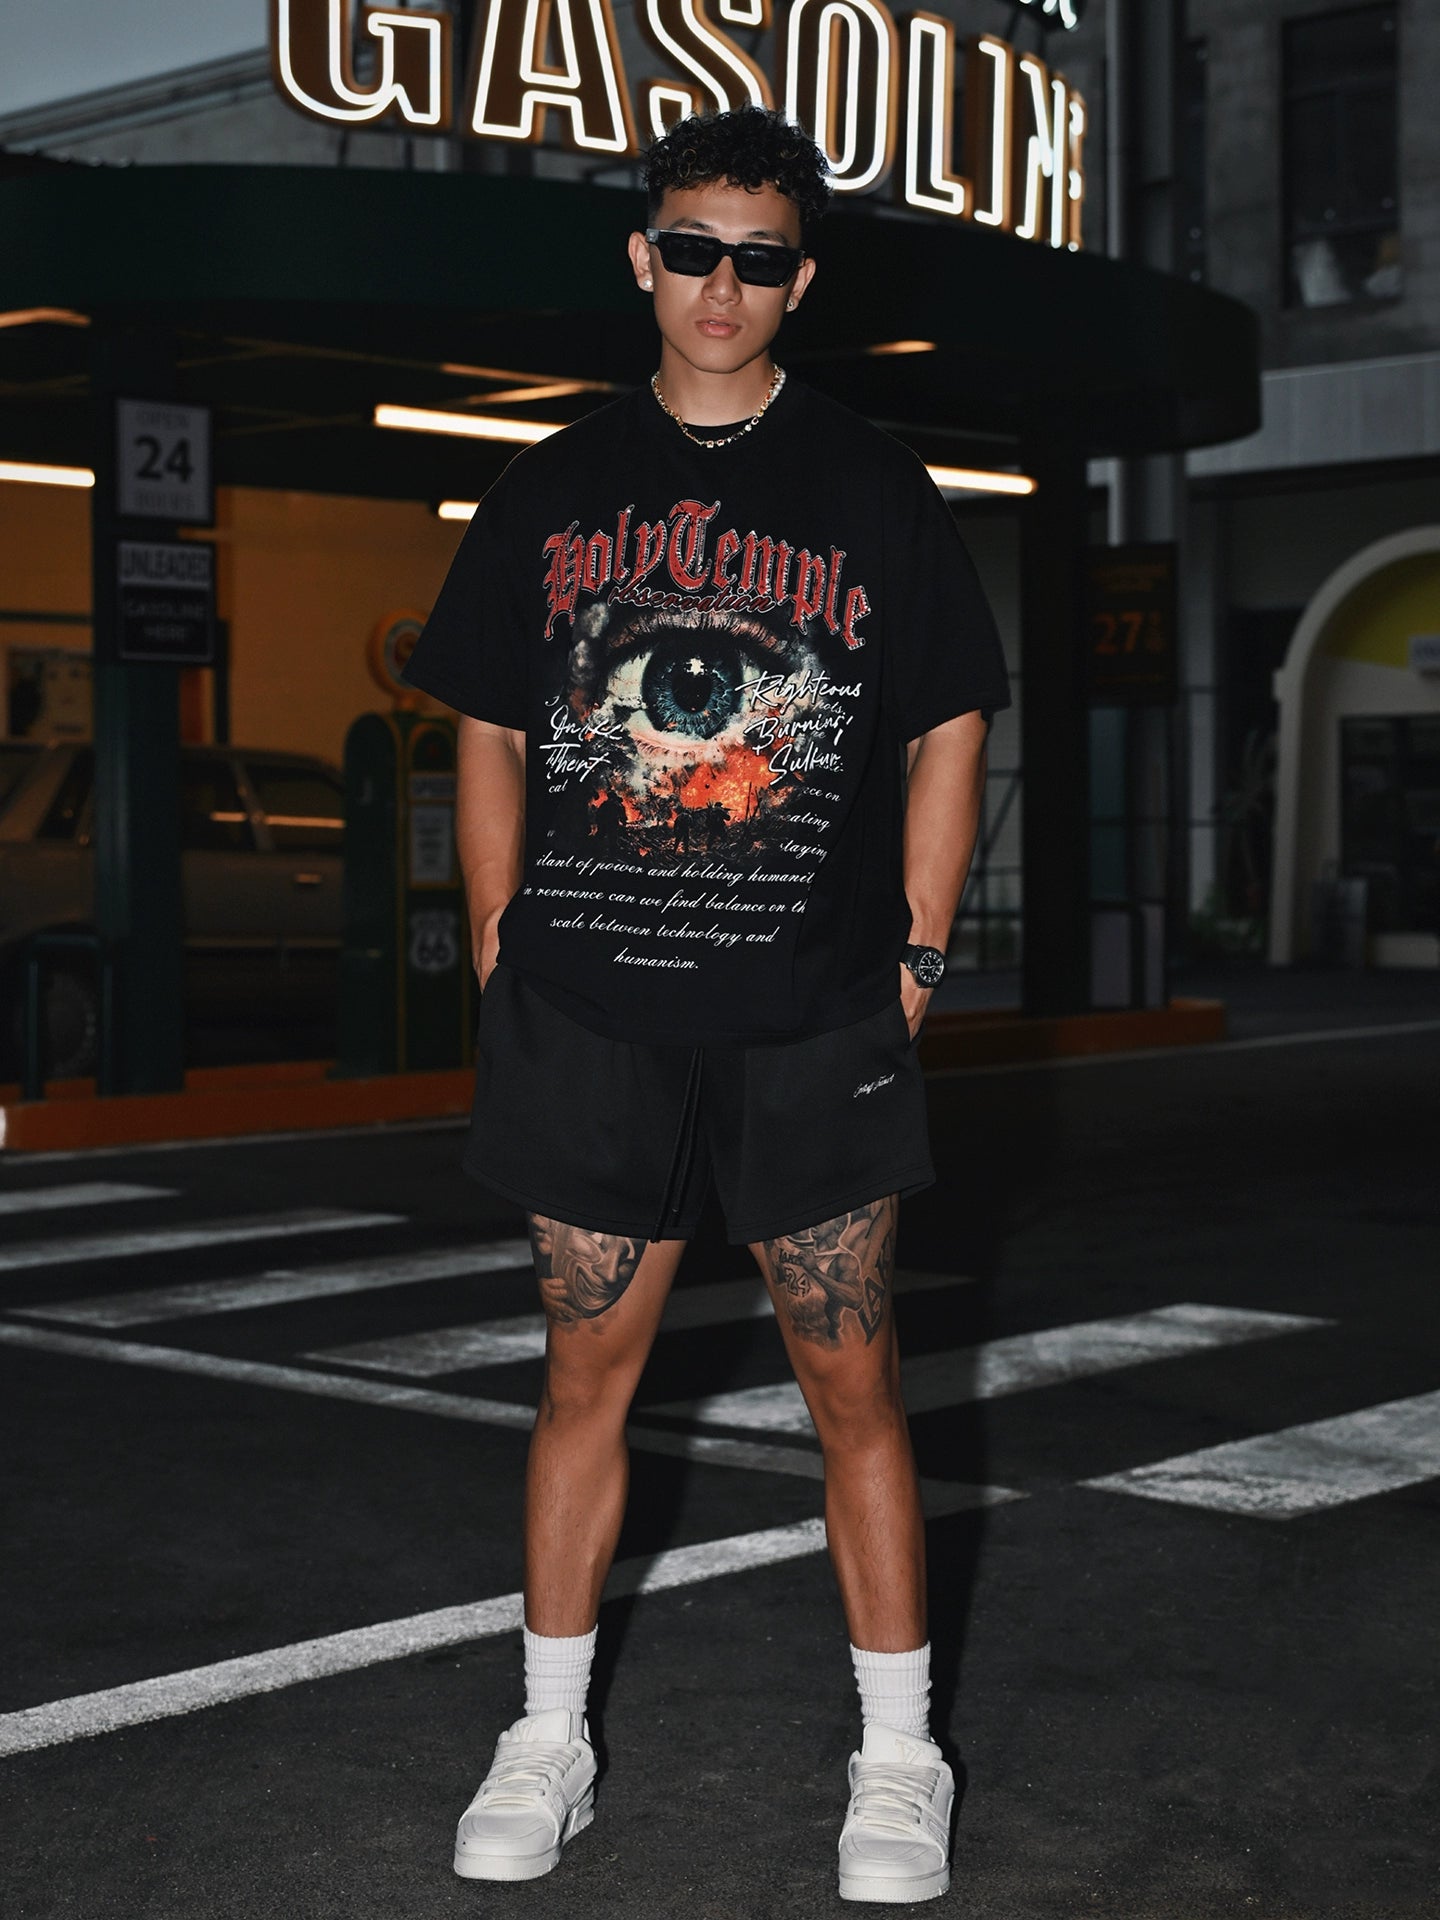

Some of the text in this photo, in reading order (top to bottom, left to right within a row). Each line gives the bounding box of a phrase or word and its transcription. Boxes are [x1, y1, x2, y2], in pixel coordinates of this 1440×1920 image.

[133, 435, 194, 483] 24
[734, 669, 863, 716] Righteous
[825, 791, 842, 802] on
[575, 857, 594, 876] of
[589, 862, 644, 877] power
[647, 863, 680, 878] and
[680, 862, 744, 888] holding
[536, 887, 605, 901] reverence
[608, 892, 636, 904] can
[639, 896, 664, 908] we
[661, 889, 707, 914] find
[705, 893, 766, 913] balance
[768, 903, 788, 913] on
[550, 912, 777, 948] scale between technology and
[613, 946, 700, 970] humanism.
[785, 1267, 811, 1297] 24
